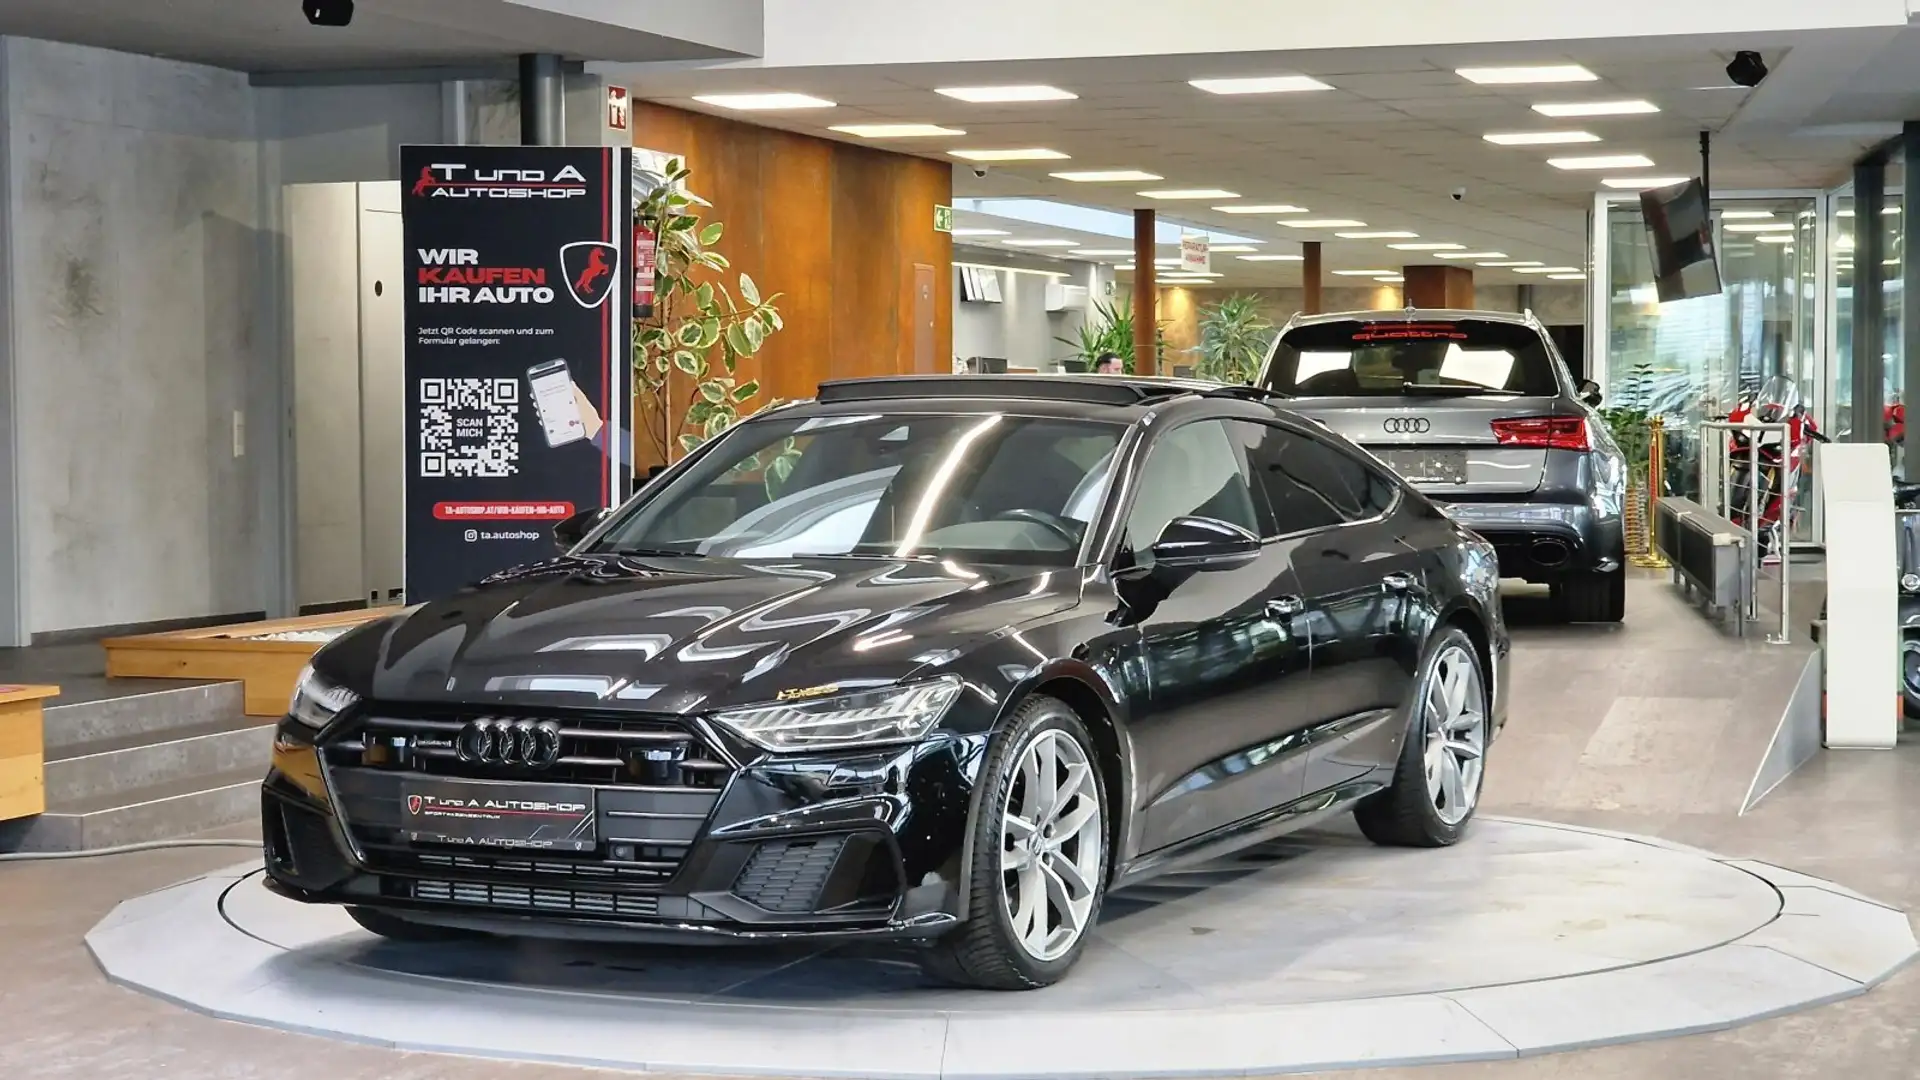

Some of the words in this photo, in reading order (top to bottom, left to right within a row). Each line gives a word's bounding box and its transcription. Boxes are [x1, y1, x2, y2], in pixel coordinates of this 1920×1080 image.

[431, 163, 467, 181] T
[552, 164, 587, 182] A
[431, 187, 587, 199] AUTOSHOP
[417, 248, 479, 265] WIR
[418, 268, 545, 285] KAUFEN
[418, 287, 473, 304] IHR
[473, 287, 555, 304] AUTO
[418, 327, 440, 335] Jetzt
[441, 327, 454, 336] QR
[455, 327, 478, 335] Code
[516, 327, 534, 335] und
[1352, 331, 1467, 340] quattro
[418, 337, 457, 345] Formular
[456, 418, 483, 427] SCAN
[456, 428, 483, 437] MICH
[480, 530, 540, 541] ta.autoshop
[424, 796, 435, 805] T
[468, 799, 480, 807] A
[484, 801, 586, 812] AUTOSHOP
[437, 835, 447, 844] T
[463, 837, 475, 845] A
[478, 838, 553, 849] AUTOSHOP
